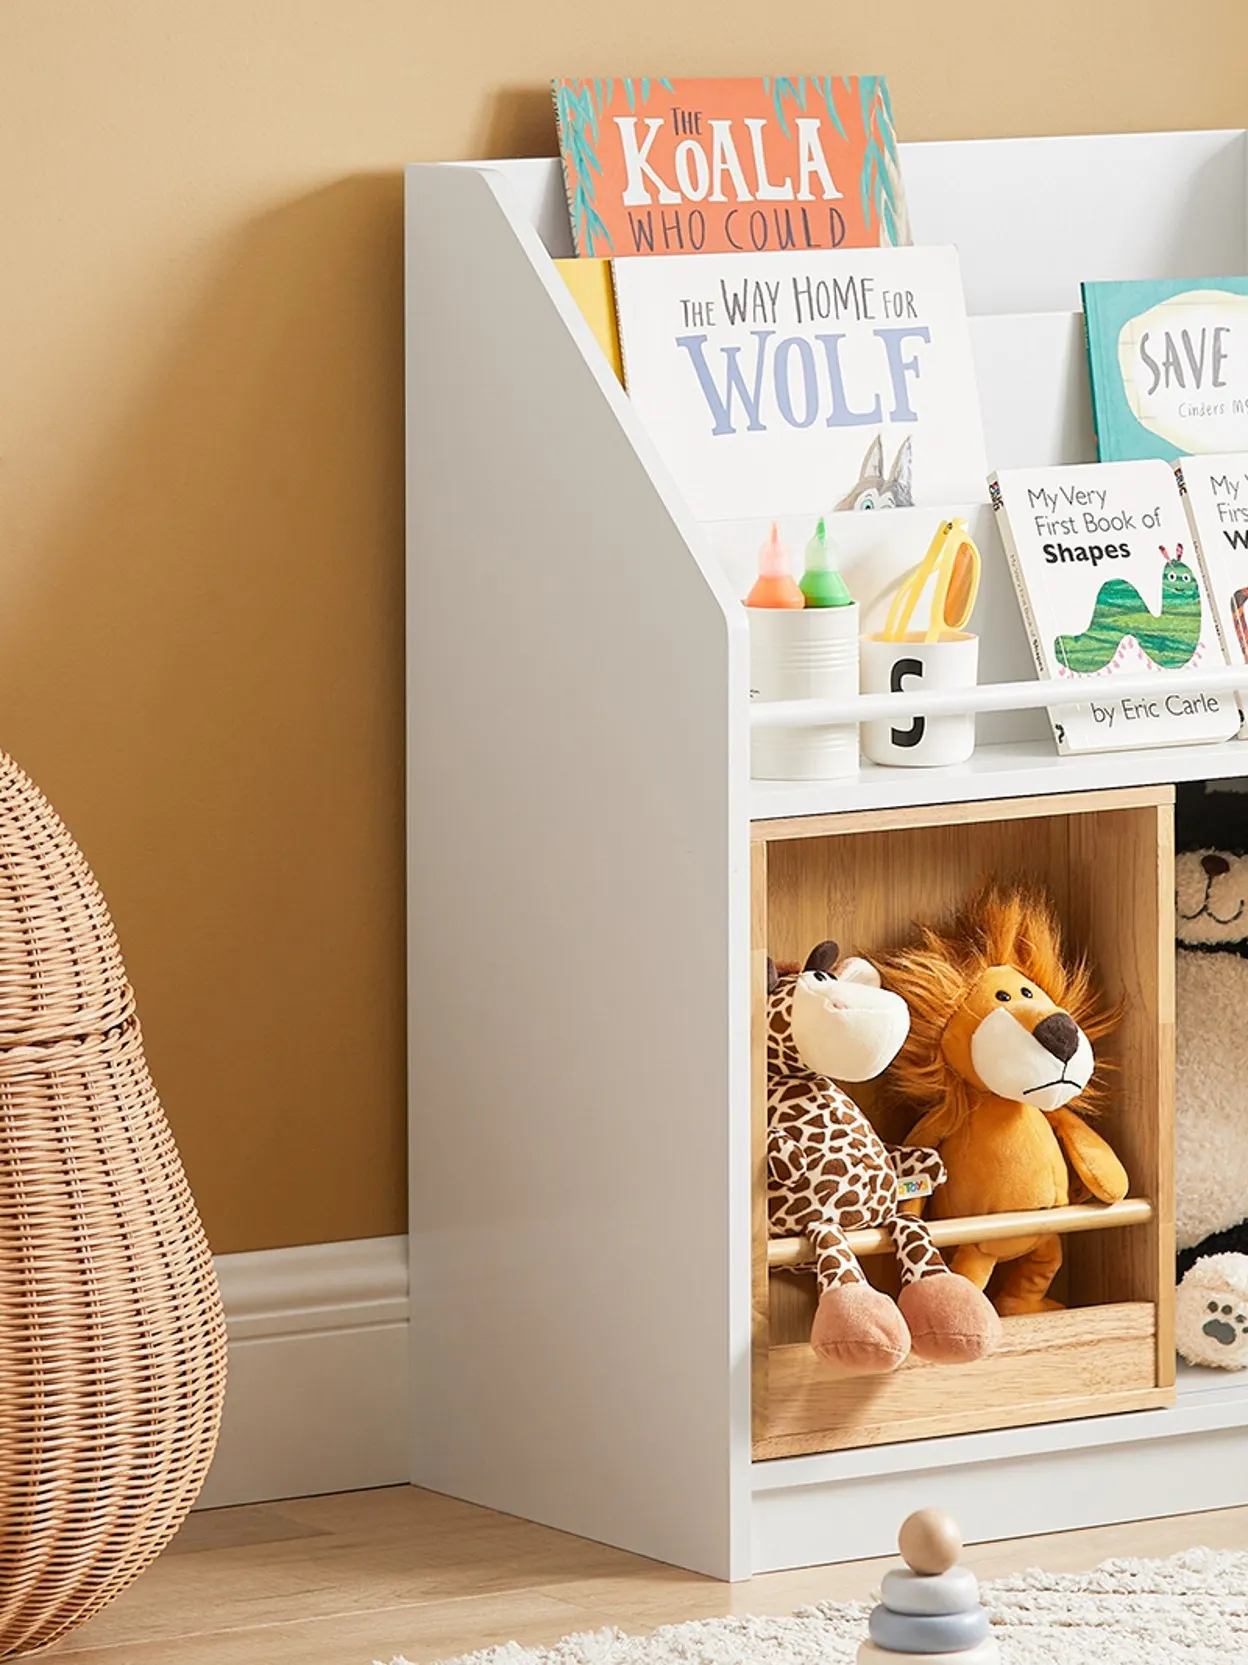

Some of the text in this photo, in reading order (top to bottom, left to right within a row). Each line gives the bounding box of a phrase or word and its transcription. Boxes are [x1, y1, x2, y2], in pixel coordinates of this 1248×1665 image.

[671, 107, 703, 136] THE
[612, 115, 844, 206] KOALA
[627, 207, 846, 252] WHO COULD
[680, 275, 918, 327] THE WAY HOME FOR
[1139, 326, 1231, 396] SAVE
[675, 325, 932, 436] WOLF
[1178, 399, 1225, 418] Cinders
[1027, 485, 1107, 513] My Very
[1209, 475, 1240, 500] My
[1034, 506, 1162, 537] First Book of
[1042, 542, 1131, 566] Shapes
[890, 658, 925, 747] S
[1090, 693, 1220, 728] by Eric Carle
